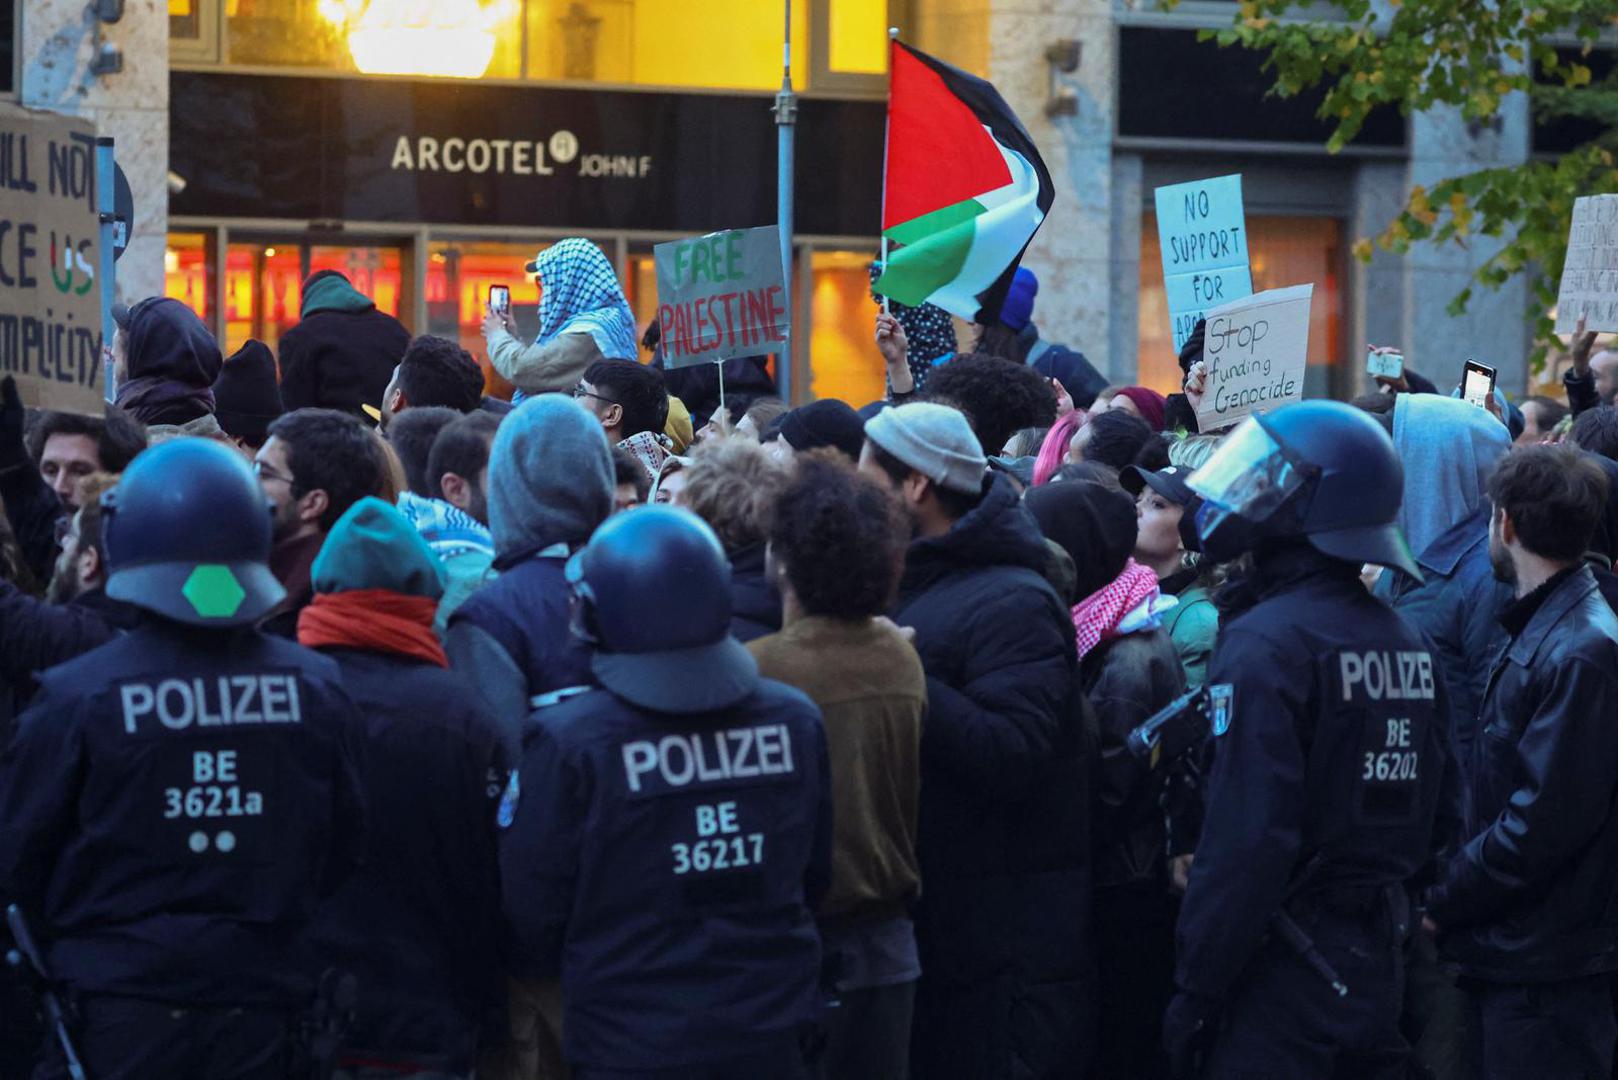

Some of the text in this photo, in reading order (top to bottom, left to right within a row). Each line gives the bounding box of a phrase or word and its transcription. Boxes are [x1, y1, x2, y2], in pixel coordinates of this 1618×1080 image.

[48, 131, 97, 213] NOT
[391, 135, 553, 175] ARCOTEL
[578, 154, 636, 178] JOHN
[639, 156, 652, 178] F
[1184, 189, 1210, 225] NO
[51, 231, 94, 296] US
[673, 231, 745, 284] FREE
[1170, 227, 1240, 265] SUPPORT
[1193, 273, 1224, 304] FOR
[659, 284, 788, 359] PALESTINE
[1208, 317, 1269, 355] Stop
[1209, 356, 1272, 385] funding
[1214, 372, 1296, 415] Genocide
[120, 674, 301, 733] POLIZEI
[1386, 718, 1411, 748] BE
[193, 750, 237, 783] BE
[621, 723, 795, 792] POLIZEI
[163, 785, 263, 819] 3621a
[695, 801, 740, 838] BE
[671, 832, 765, 875] 36217
